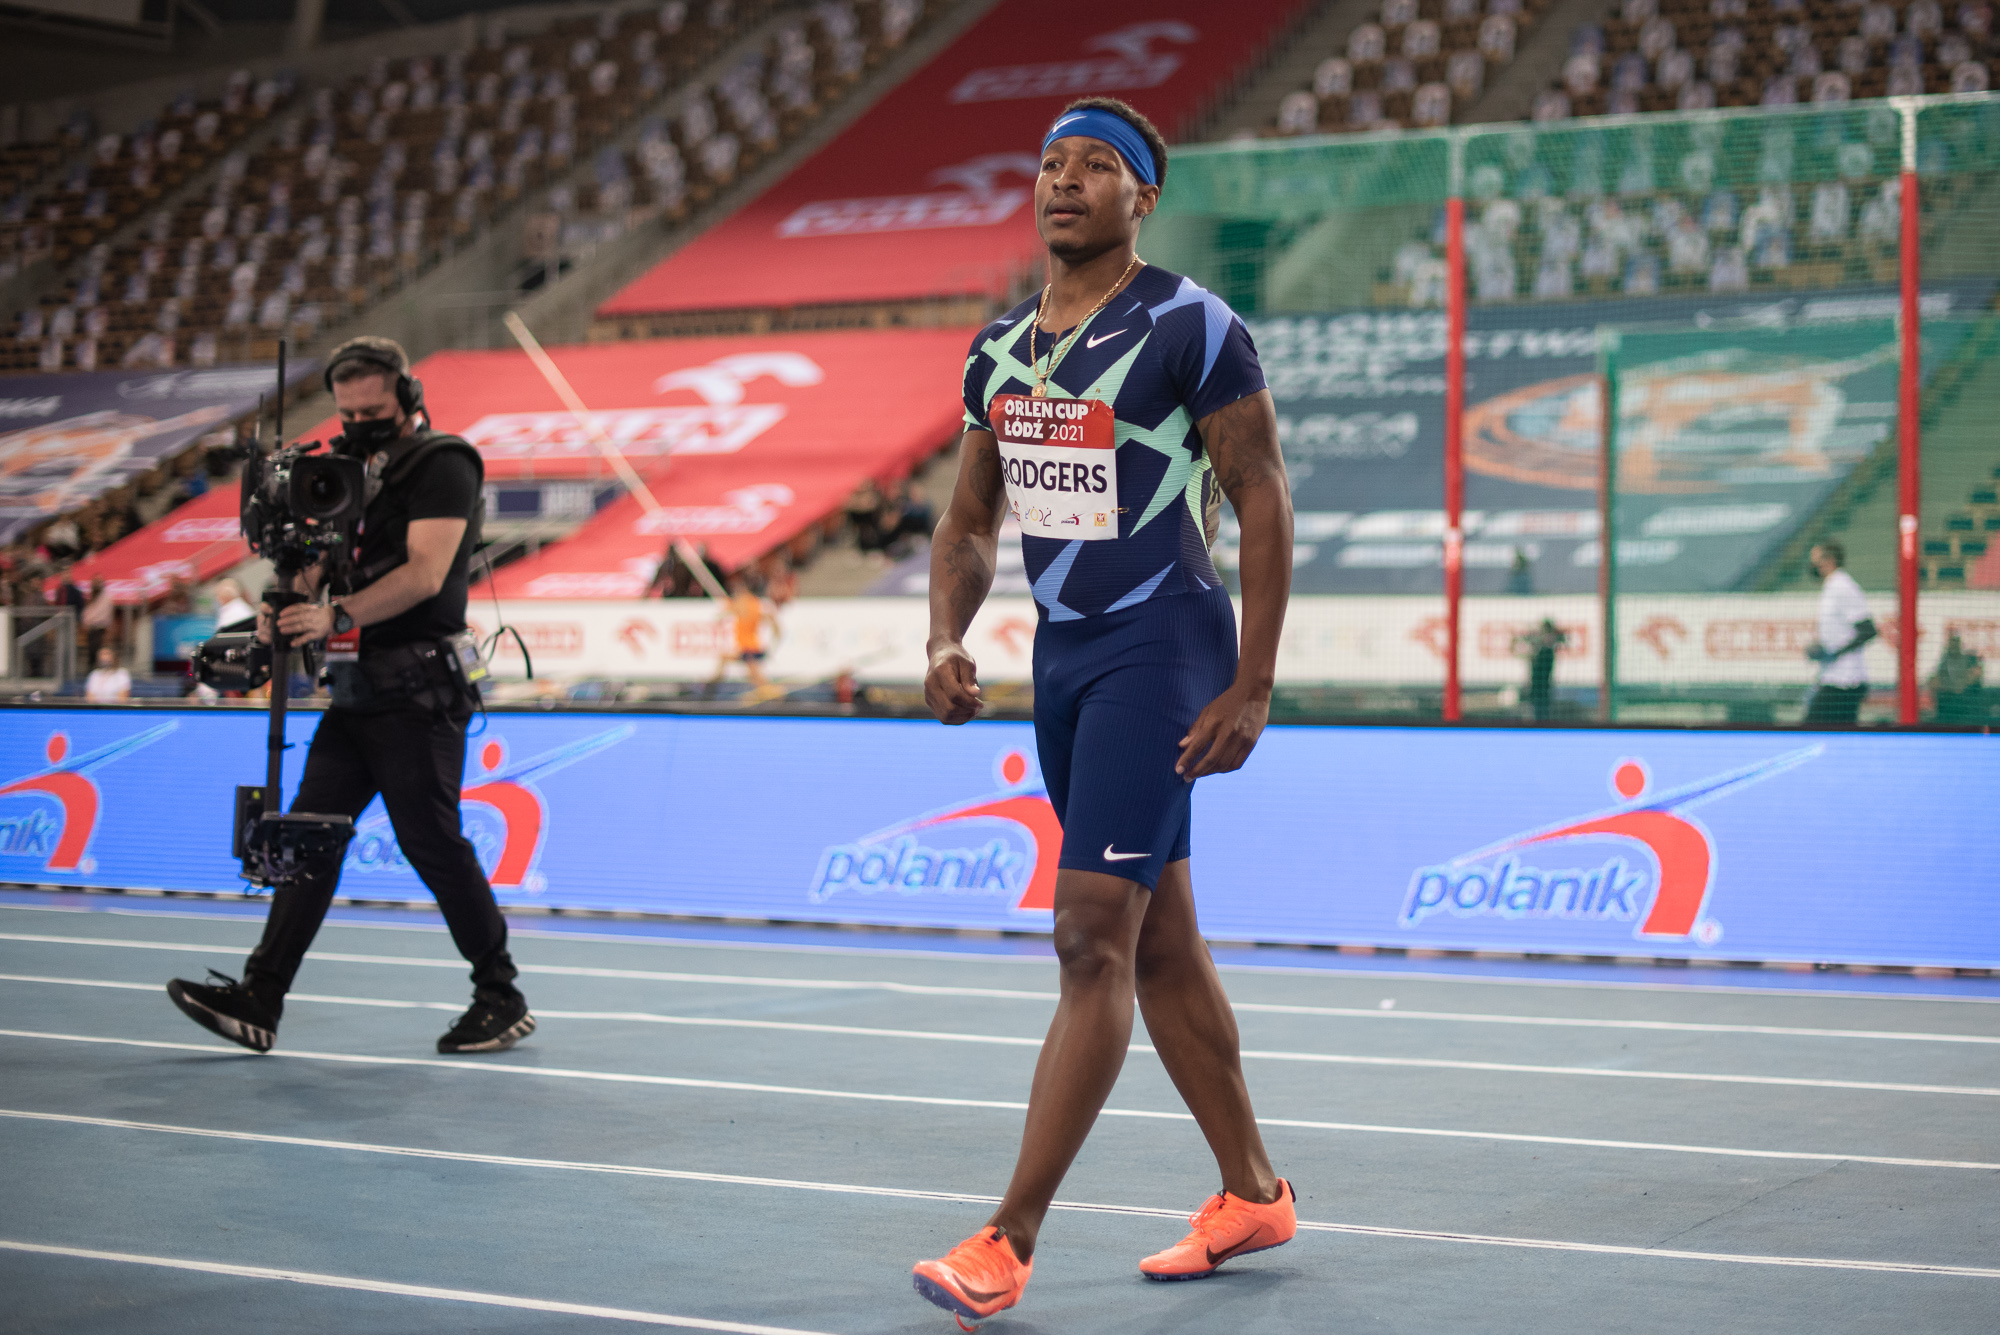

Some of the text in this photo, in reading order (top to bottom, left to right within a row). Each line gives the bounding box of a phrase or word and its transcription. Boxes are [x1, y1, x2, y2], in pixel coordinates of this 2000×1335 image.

[1004, 399, 1089, 420] ORLEN CUP
[1004, 417, 1084, 441] ŁÓDŹ 2021
[1000, 455, 1108, 493] RODGERS
[816, 841, 1017, 896] polanik
[1404, 861, 1641, 919] polanik
